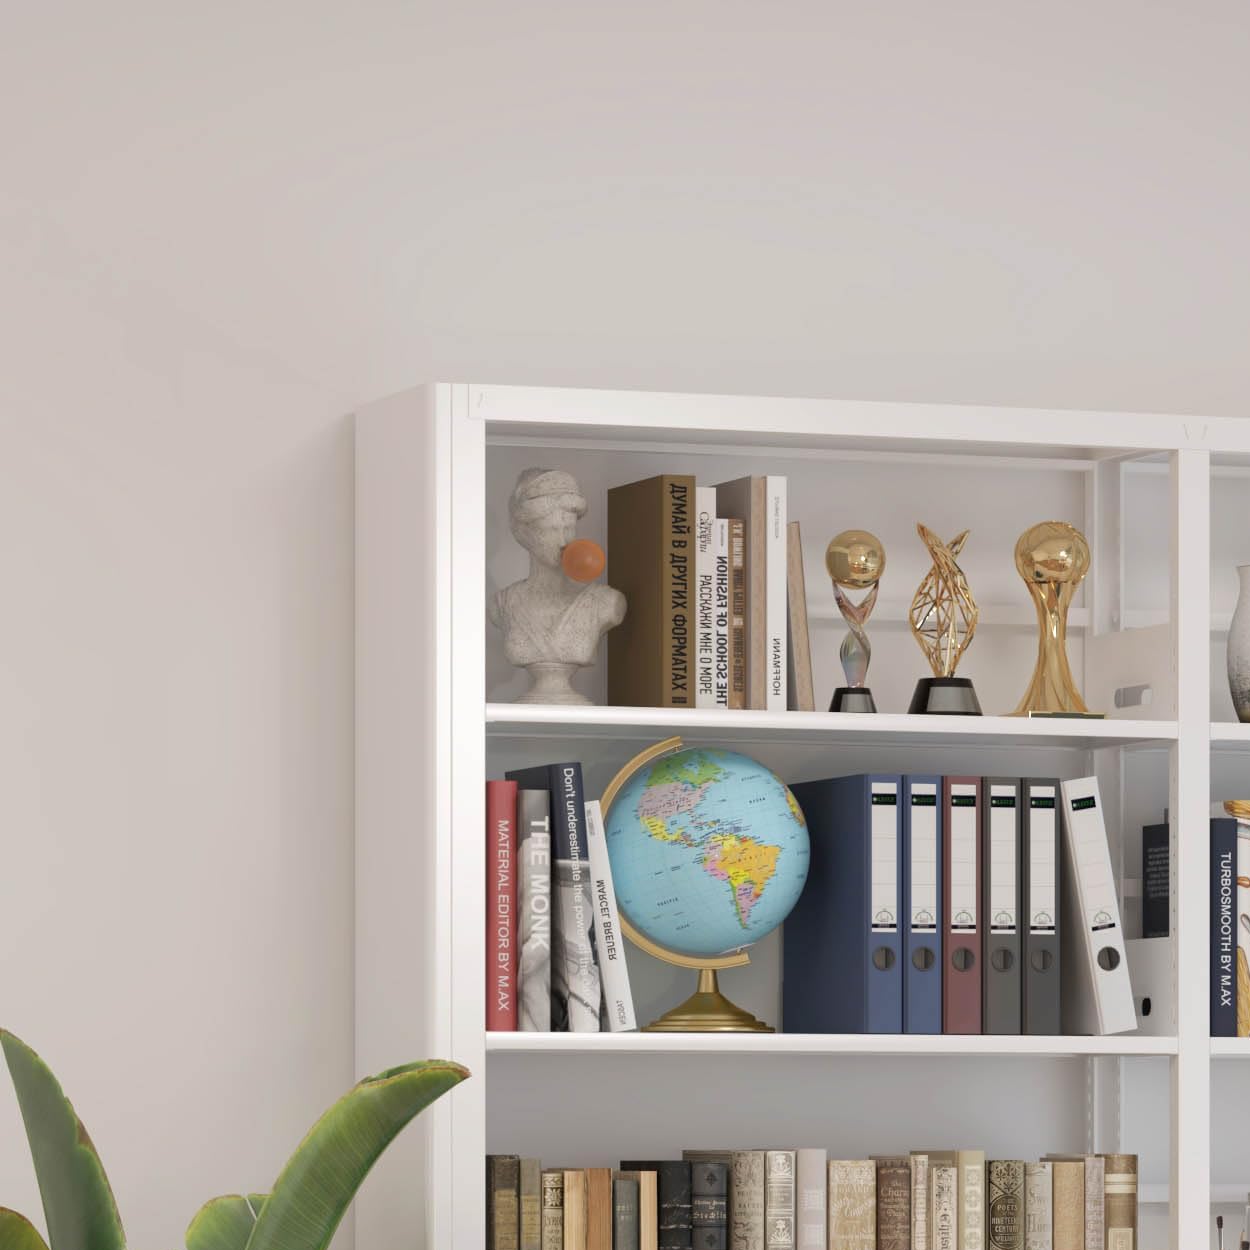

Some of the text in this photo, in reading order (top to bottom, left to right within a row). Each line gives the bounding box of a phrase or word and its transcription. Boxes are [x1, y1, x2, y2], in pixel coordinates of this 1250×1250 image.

[670, 483, 691, 534] ДУМАЙ
[672, 540, 687, 549] В
[670, 553, 688, 609] ДРУГИХ
[700, 575, 712, 629] РАССКАЖИ
[672, 614, 688, 691] ФОРМАТАХ
[700, 632, 712, 654] МНЕ
[700, 667, 712, 695] МОРЕ
[563, 768, 575, 798] Don't
[565, 801, 582, 881] underestimate
[530, 816, 549, 951] THE MONK
[572, 884, 584, 902] the
[498, 820, 510, 1010] MATERIAL EDITOR BY M.AX
[573, 905, 586, 940] power
[1220, 852, 1231, 1006] TURBOSMOOTH BY M.AX
